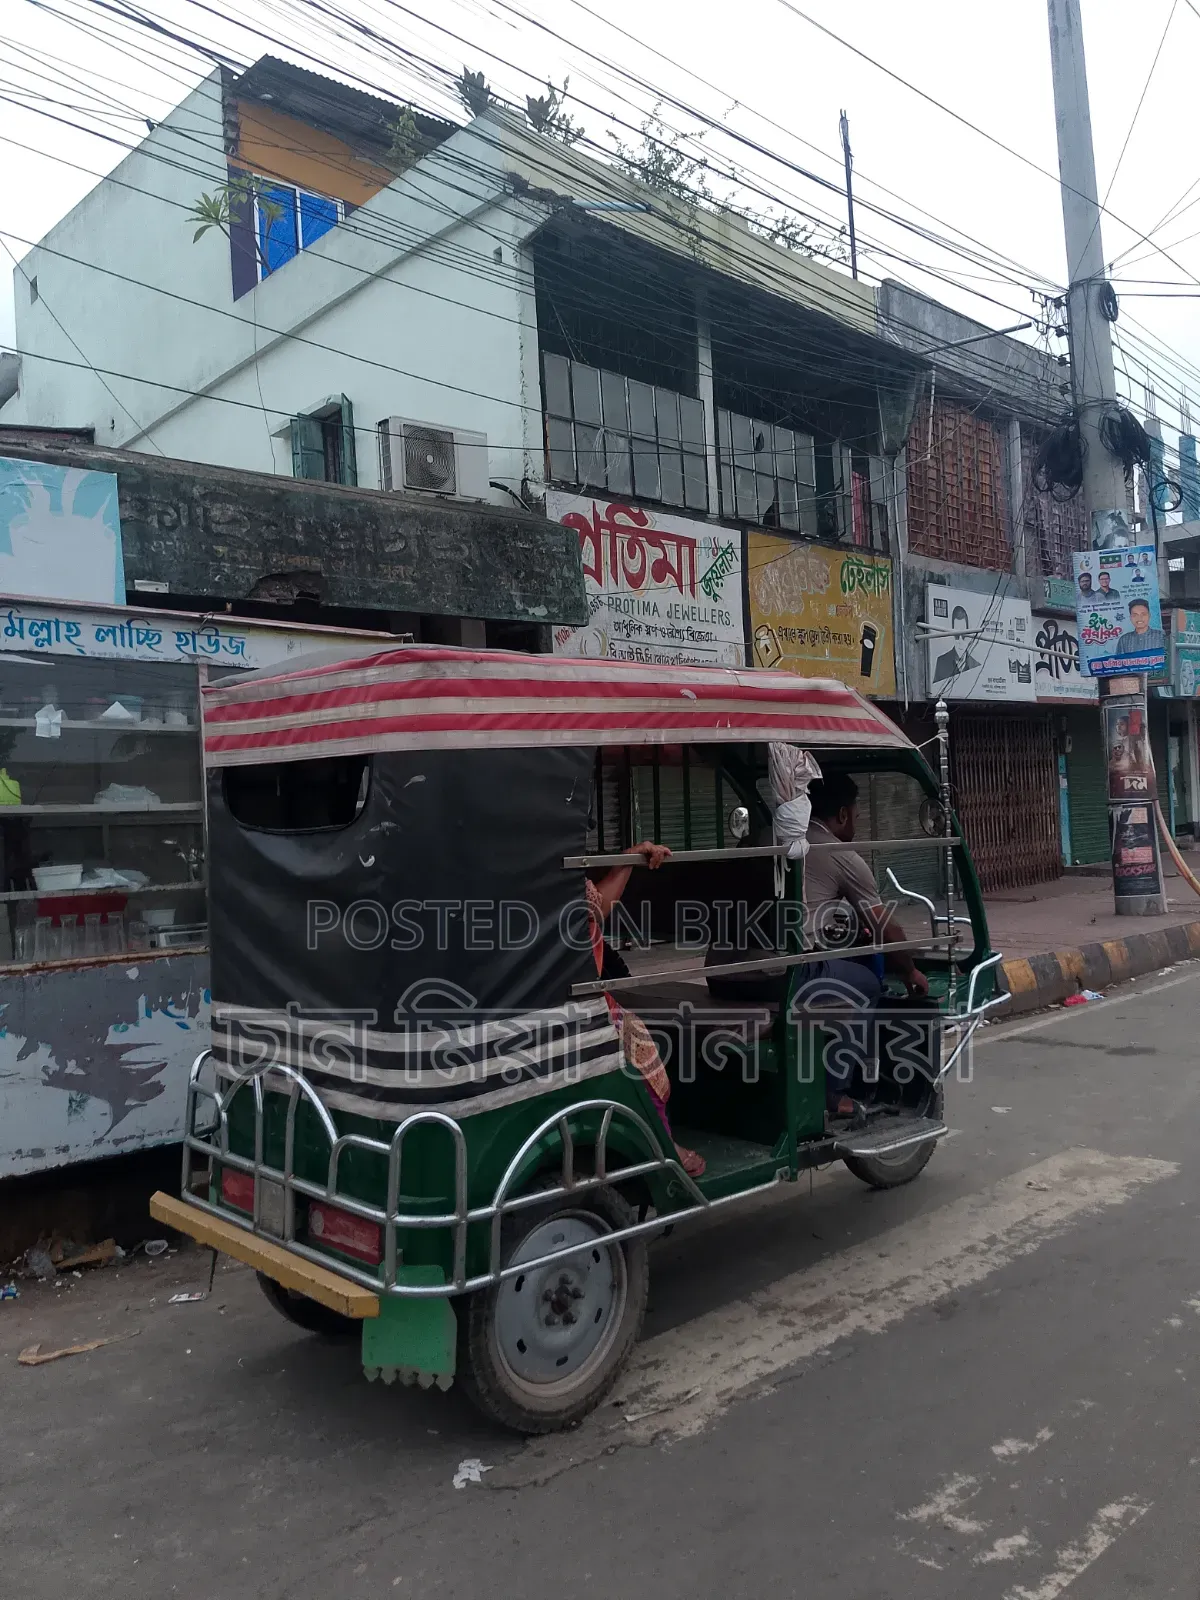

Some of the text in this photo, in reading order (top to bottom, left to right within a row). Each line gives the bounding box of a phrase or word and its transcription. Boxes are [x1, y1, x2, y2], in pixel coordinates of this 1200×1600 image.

[560, 499, 697, 600] প্রতিমা
[607, 596, 661, 618] PROTIMA
[92, 618, 163, 653] লাচ্ছি
[172, 626, 249, 661] হাউজ
[613, 619, 642, 638] আধুনিক
